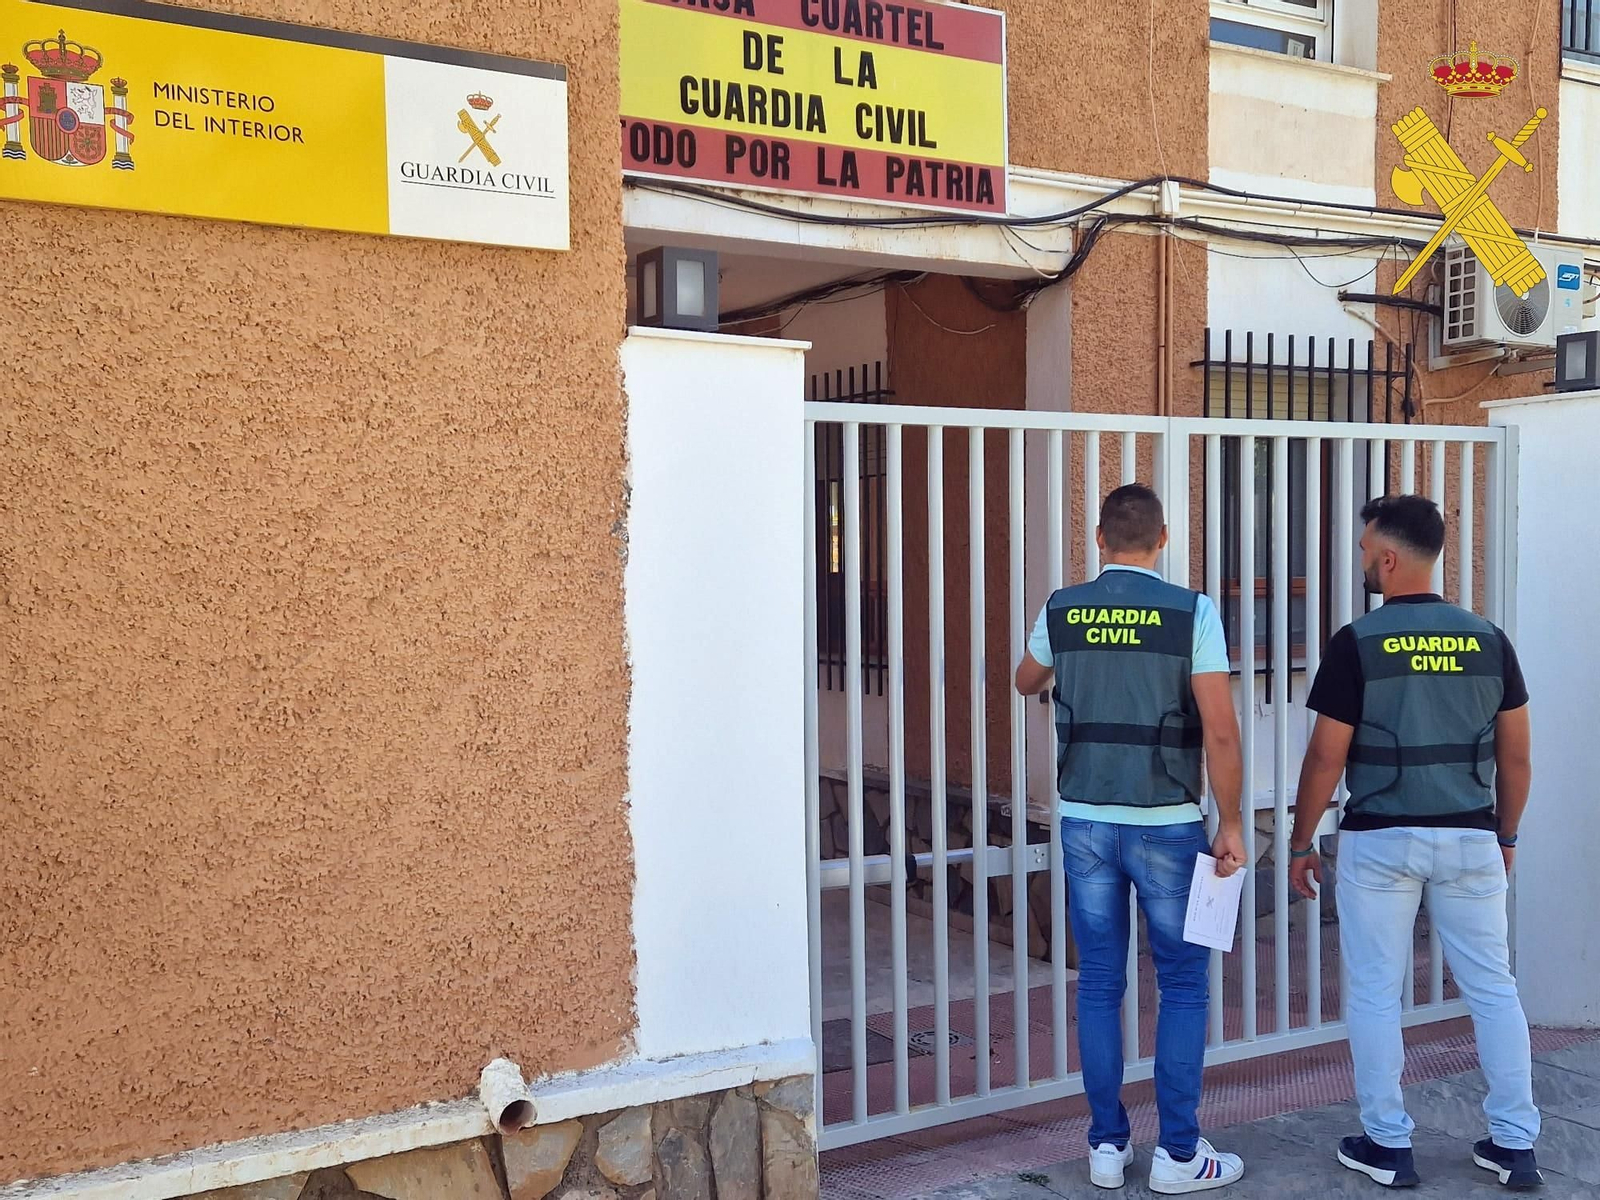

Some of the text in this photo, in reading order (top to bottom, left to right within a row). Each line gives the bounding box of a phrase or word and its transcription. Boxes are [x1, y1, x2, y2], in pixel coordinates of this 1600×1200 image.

[800, 0, 945, 51] CUARTEL
[743, 30, 878, 90] DE LA
[153, 81, 276, 113] MINISTERIO
[679, 75, 938, 149] GUARDIA CIVIL
[154, 109, 305, 144] DEL INTERIOR
[400, 161, 555, 194] GUARDIA CIVIL
[620, 119, 995, 206] ODO POR LA PATRIA
[1066, 608, 1162, 627] GUARDIA
[1086, 627, 1142, 645] CIVIL
[1383, 636, 1482, 654] GUARDIA
[1410, 655, 1464, 673] CIVIL
